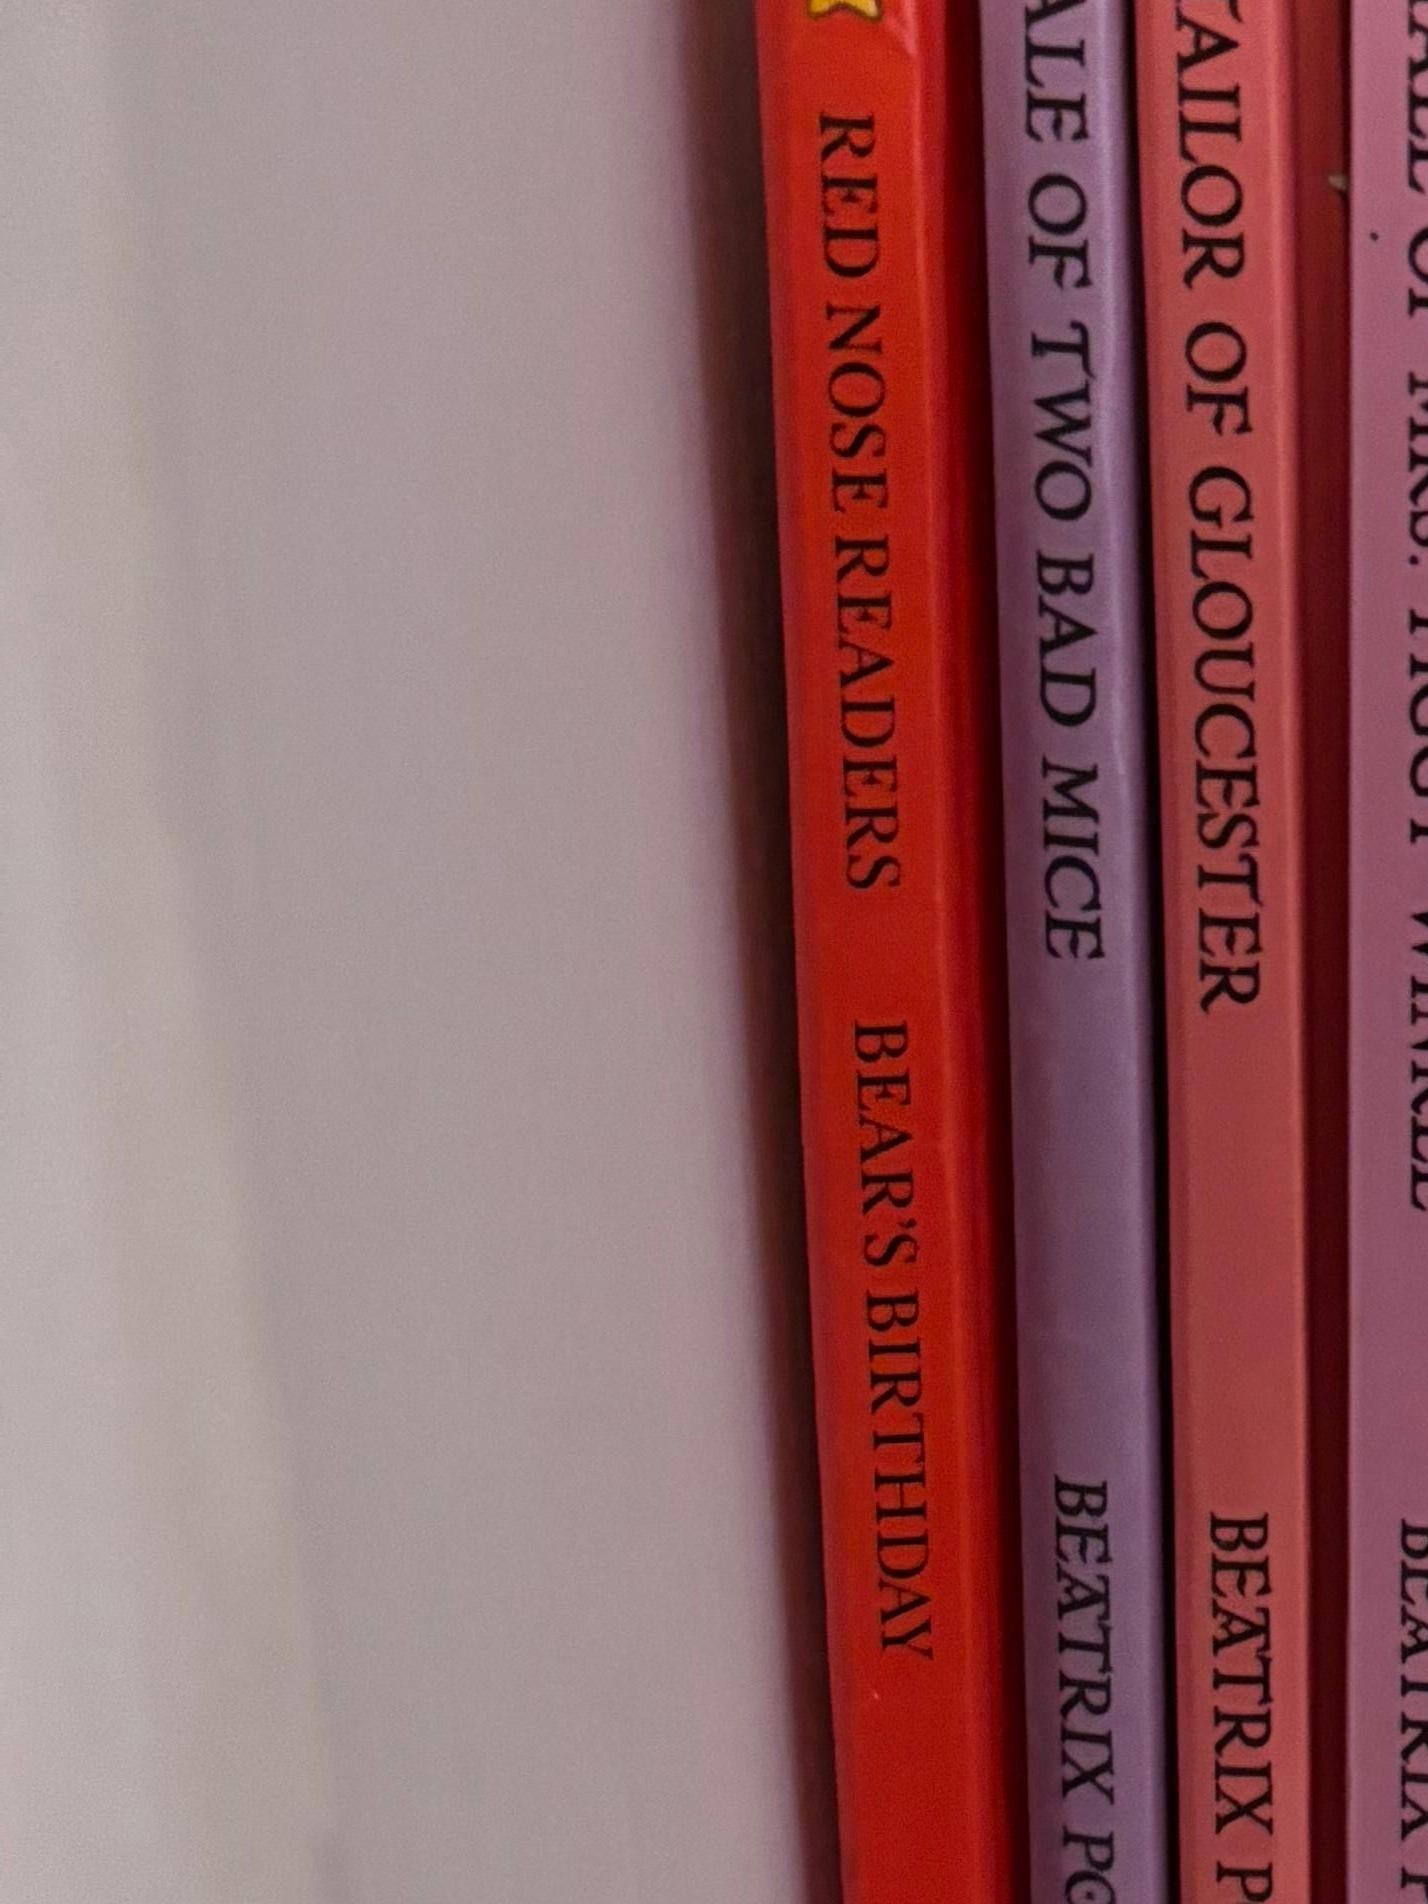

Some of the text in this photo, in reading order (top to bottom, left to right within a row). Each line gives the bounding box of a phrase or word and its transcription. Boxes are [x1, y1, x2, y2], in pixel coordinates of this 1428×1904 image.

[1028, 173, 1092, 294] OF
[819, 111, 901, 888] RED NOSE READERS
[1031, 320, 1095, 521] TWO
[1185, 321, 1253, 436] OF
[1037, 551, 1098, 727] BAD
[1189, 460, 1263, 1014] GLOUCESTER
[1042, 756, 1105, 959] MICE
[855, 1021, 934, 1660] BEAR'S BIRTHDAY
[1055, 1475, 1115, 1805] BEATRIX
[1210, 1512, 1273, 1835] BEATRIX
